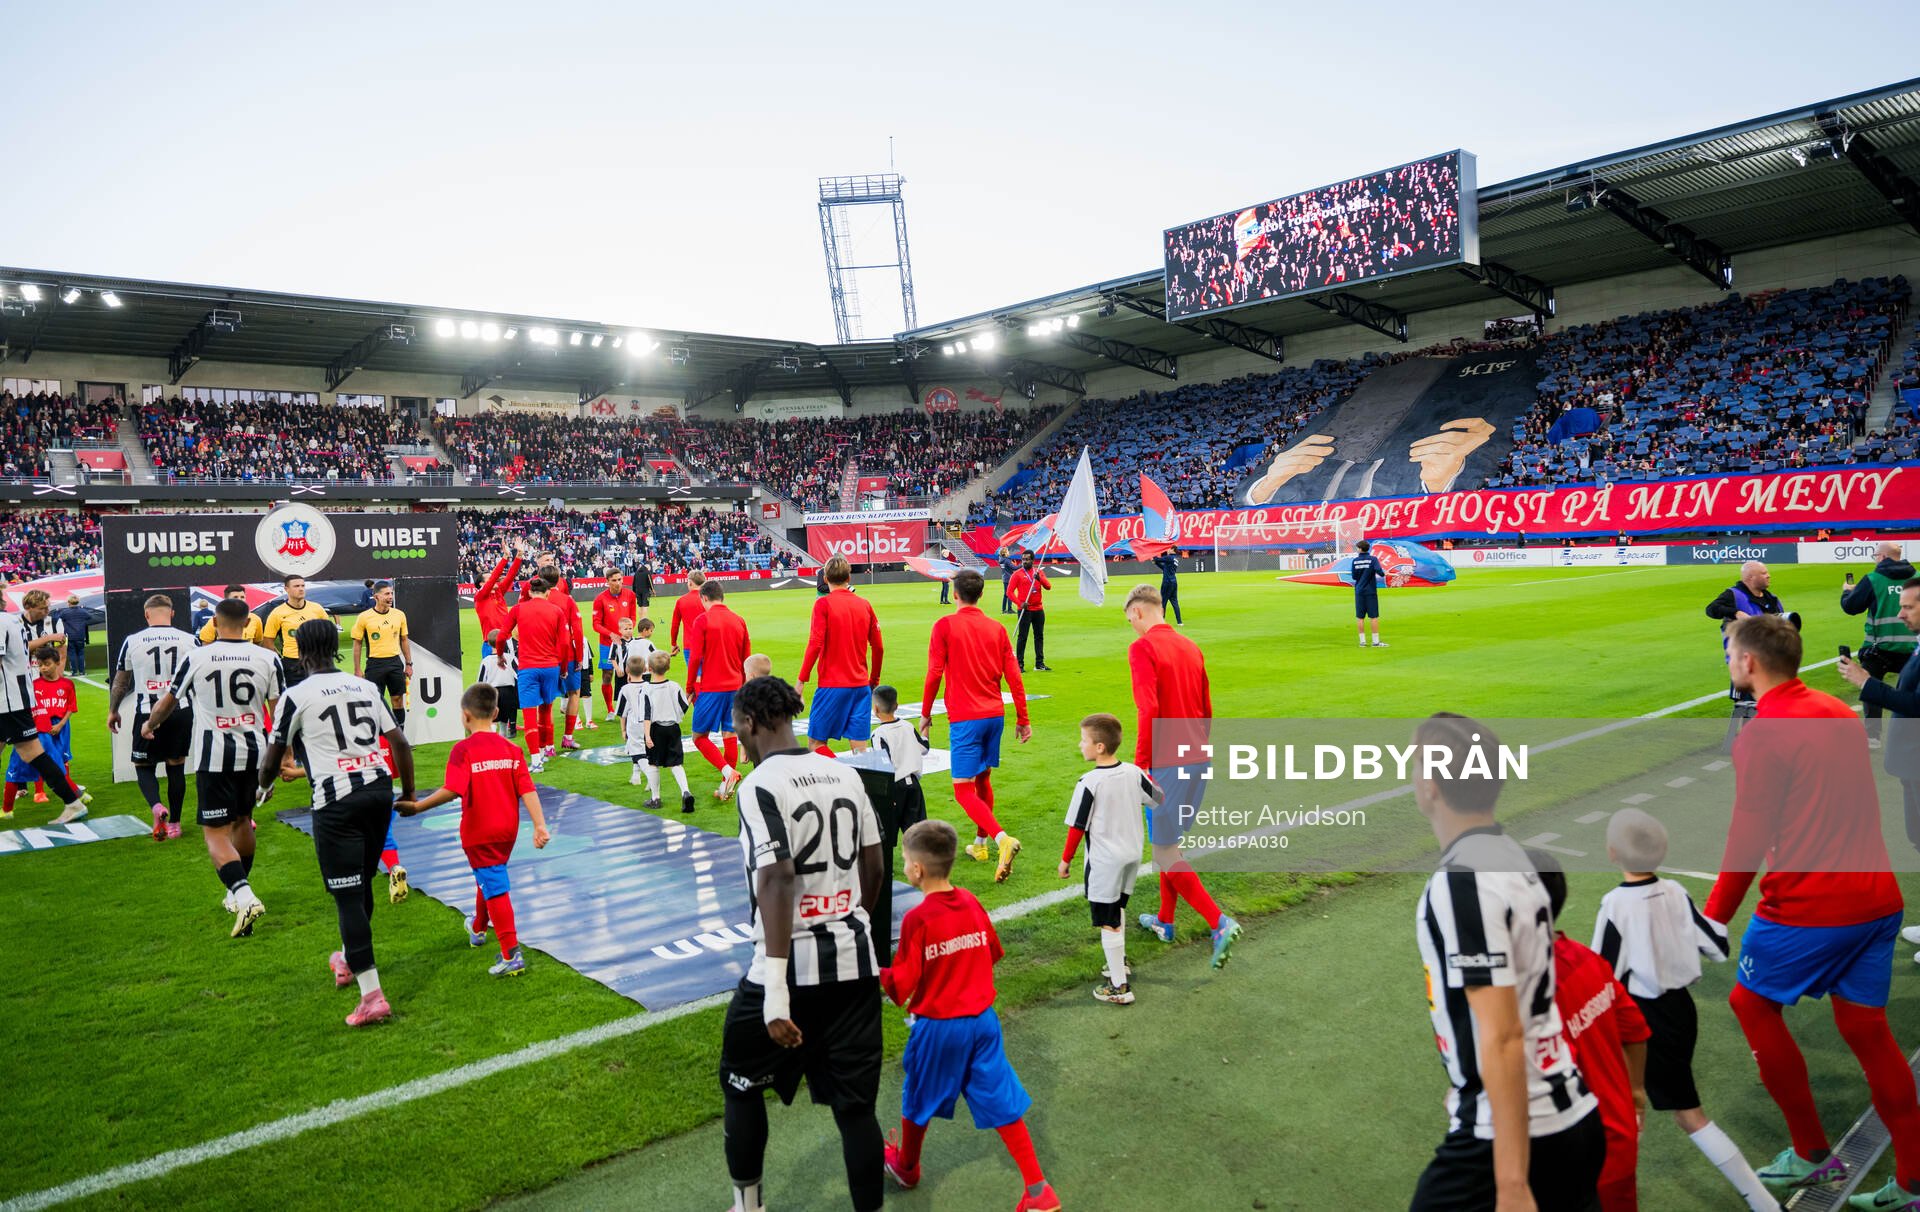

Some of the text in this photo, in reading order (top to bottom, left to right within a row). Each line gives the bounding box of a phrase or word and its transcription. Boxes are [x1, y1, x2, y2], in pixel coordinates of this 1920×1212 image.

[1458, 360, 1517, 378] HIF
[591, 398, 617, 415] MAX
[1277, 501, 1351, 539] STÅR
[1357, 496, 1428, 531] DET
[1561, 482, 1615, 526] PÅ
[1625, 478, 1729, 521] MIN
[1735, 467, 1904, 513] MENY
[126, 531, 234, 553] UNIBET
[354, 527, 441, 548] UNIBET
[825, 531, 911, 555] vobbiz
[1486, 551, 1527, 560] AllOffice
[1692, 545, 1768, 559] kondektor
[1887, 585, 1903, 595] FO
[146, 646, 178, 675] 11
[205, 668, 255, 708] 16
[420, 677, 441, 704] U
[218, 714, 254, 728] PULS
[318, 700, 377, 752] 15
[791, 797, 859, 875] 20
